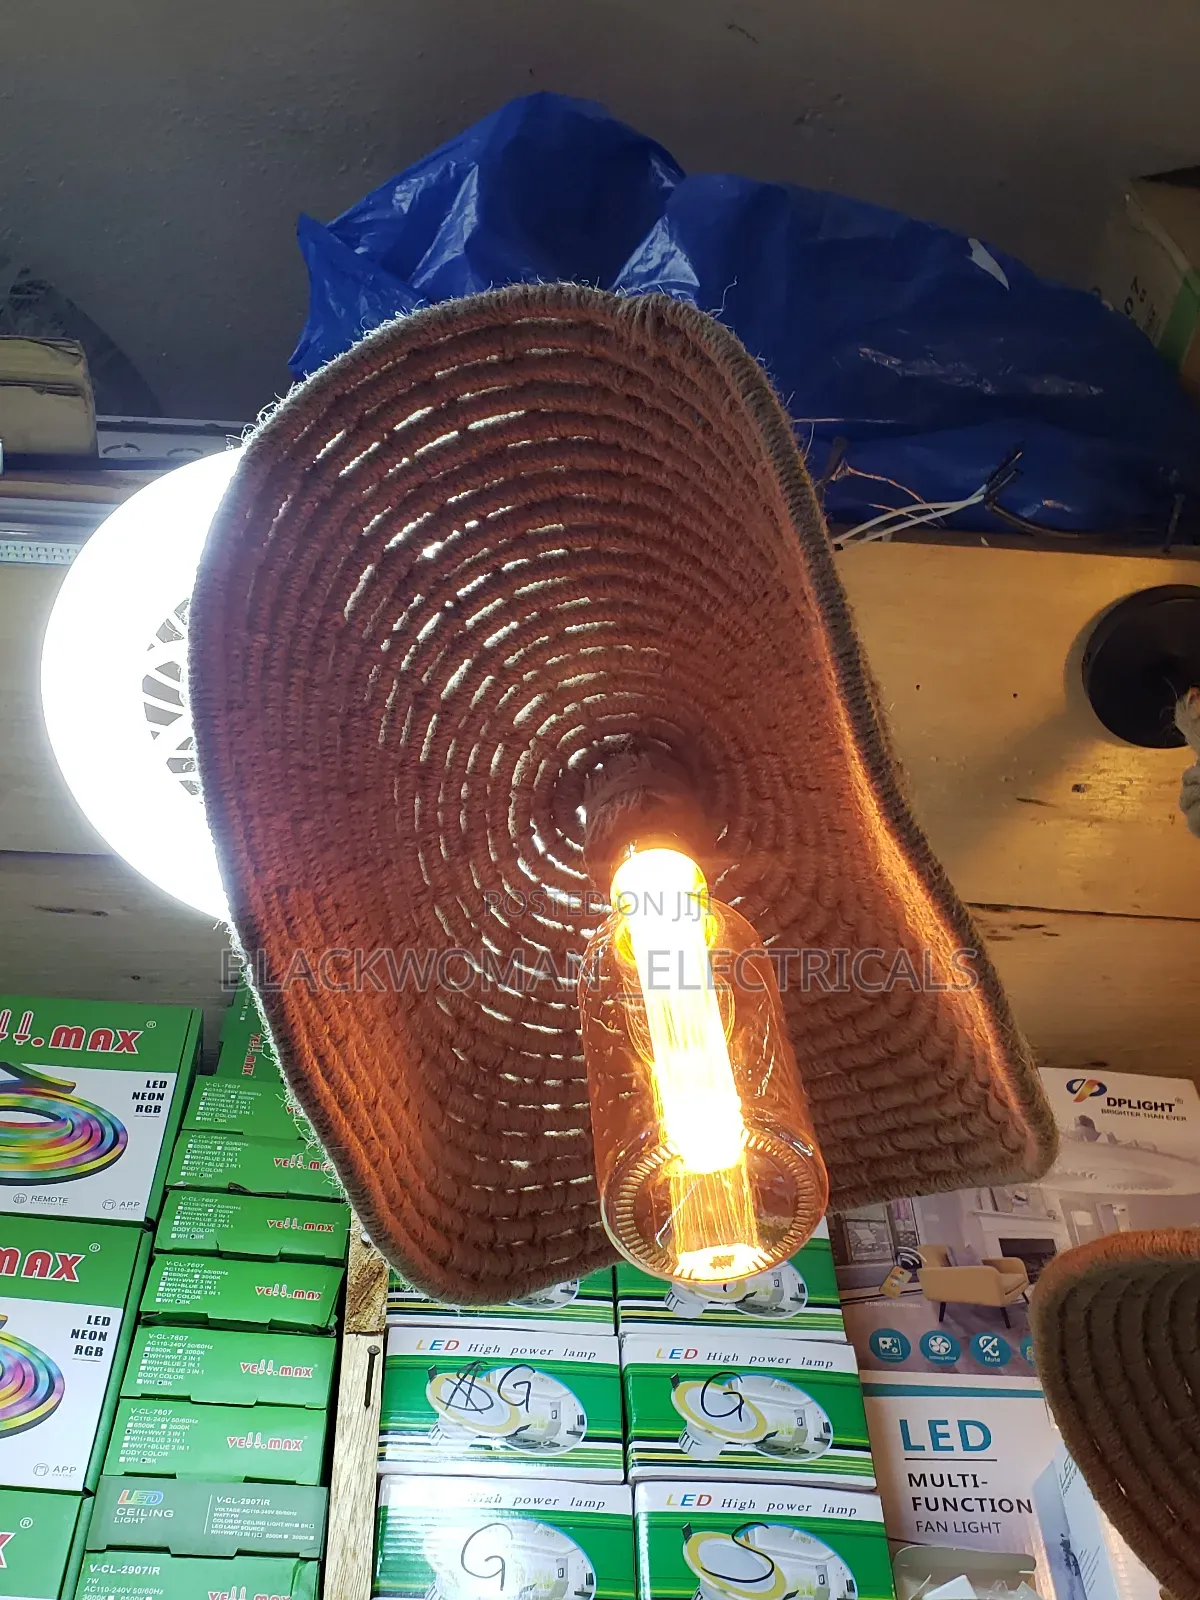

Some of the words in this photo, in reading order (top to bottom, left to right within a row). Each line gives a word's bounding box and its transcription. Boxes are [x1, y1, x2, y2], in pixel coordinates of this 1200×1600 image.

[146, 1080, 167, 1089] LED
[132, 1092, 164, 1101] NEON
[135, 1105, 162, 1113] RGB
[1107, 1097, 1175, 1113] DPLIGHT
[1101, 1108, 1140, 1117] BRIGHTER
[30, 1195, 69, 1204] REMOTE
[86, 1315, 111, 1326] LED
[70, 1329, 107, 1341] NEON
[149, 1333, 188, 1341] V-CL-7607
[74, 1345, 103, 1356] RGB
[416, 1339, 460, 1350] LED
[468, 1343, 500, 1354] High
[510, 1348, 553, 1356] power
[563, 1348, 596, 1360] lamp
[656, 1348, 698, 1359] LED
[707, 1352, 739, 1363] High
[749, 1356, 791, 1364] power
[801, 1357, 833, 1368] lamp
[899, 1419, 992, 1451] LED
[52, 1465, 76, 1473] APP
[908, 1474, 987, 1488] MULTI-
[118, 1490, 163, 1505] LED
[217, 1497, 270, 1505] V-CL-2907IR
[513, 1495, 559, 1506] power
[570, 1497, 606, 1509] lamp
[666, 1494, 712, 1507] LED
[721, 1498, 756, 1510] High
[767, 1502, 812, 1512] power
[822, 1504, 857, 1517] lamp
[912, 1497, 1032, 1514] FUNCTION
[117, 1508, 174, 1517] CEILING
[916, 1521, 948, 1532] FAN
[954, 1521, 1001, 1534] LIGHT
[90, 1564, 160, 1575] V-CL-2907IR
